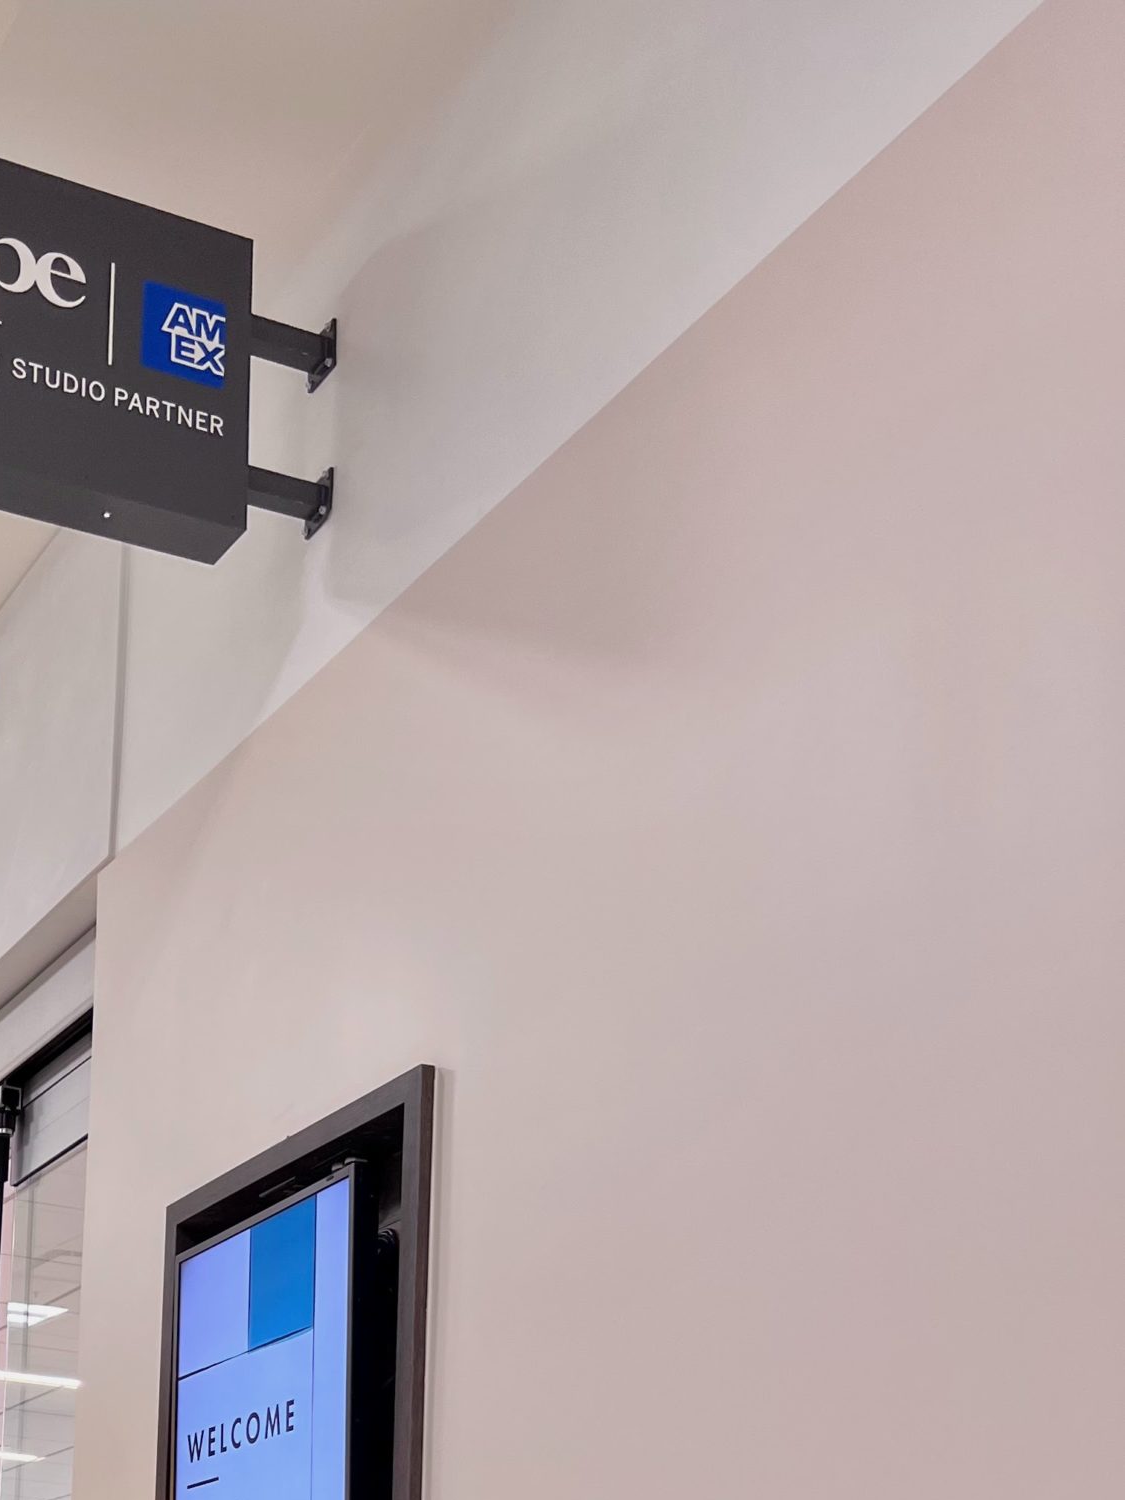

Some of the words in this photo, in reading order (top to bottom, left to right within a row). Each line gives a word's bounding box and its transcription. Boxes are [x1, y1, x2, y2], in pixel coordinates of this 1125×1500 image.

[12, 357, 105, 402] STUDIO
[113, 387, 224, 437] PARTNER
[187, 1399, 296, 1463] WELCOME
